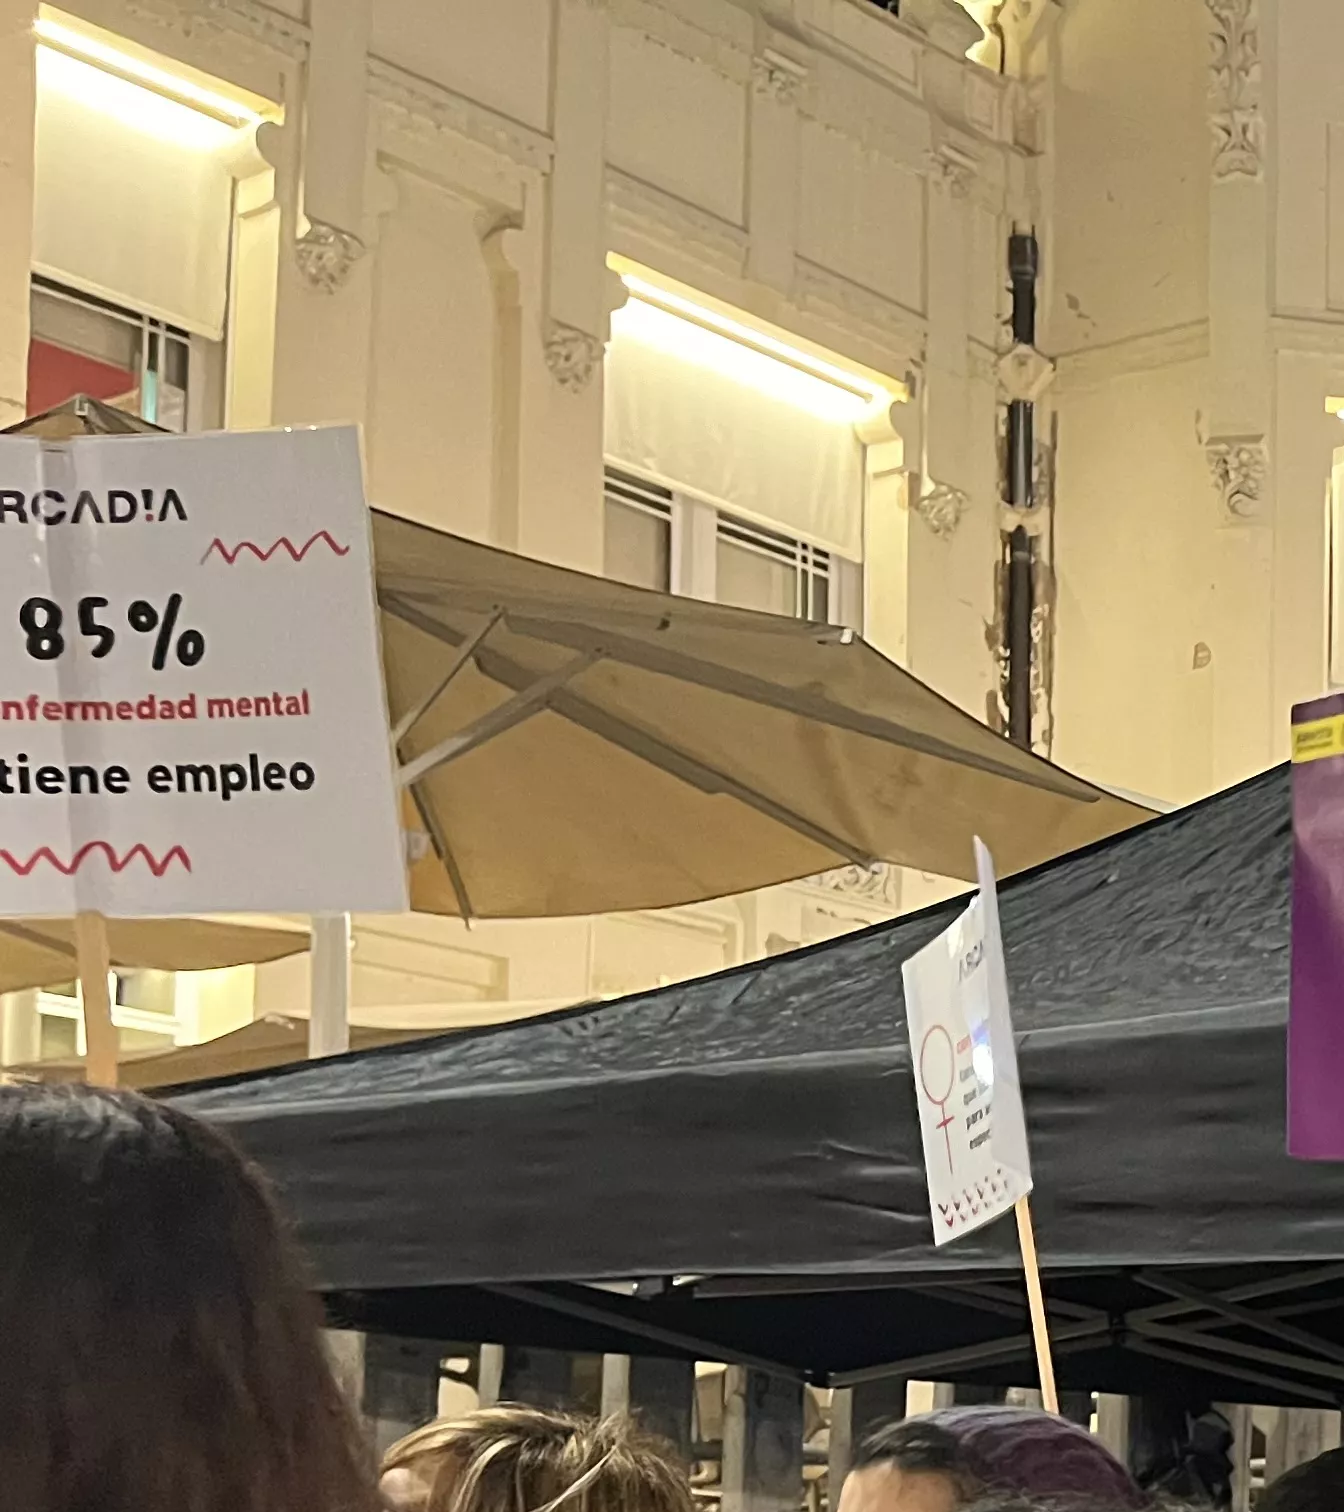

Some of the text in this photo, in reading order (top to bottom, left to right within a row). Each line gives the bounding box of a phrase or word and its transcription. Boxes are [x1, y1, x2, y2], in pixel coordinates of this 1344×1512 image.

[19, 593, 205, 671] 85%
[0, 689, 310, 721] nfermedad mental
[0, 752, 317, 801] tiene empleo
